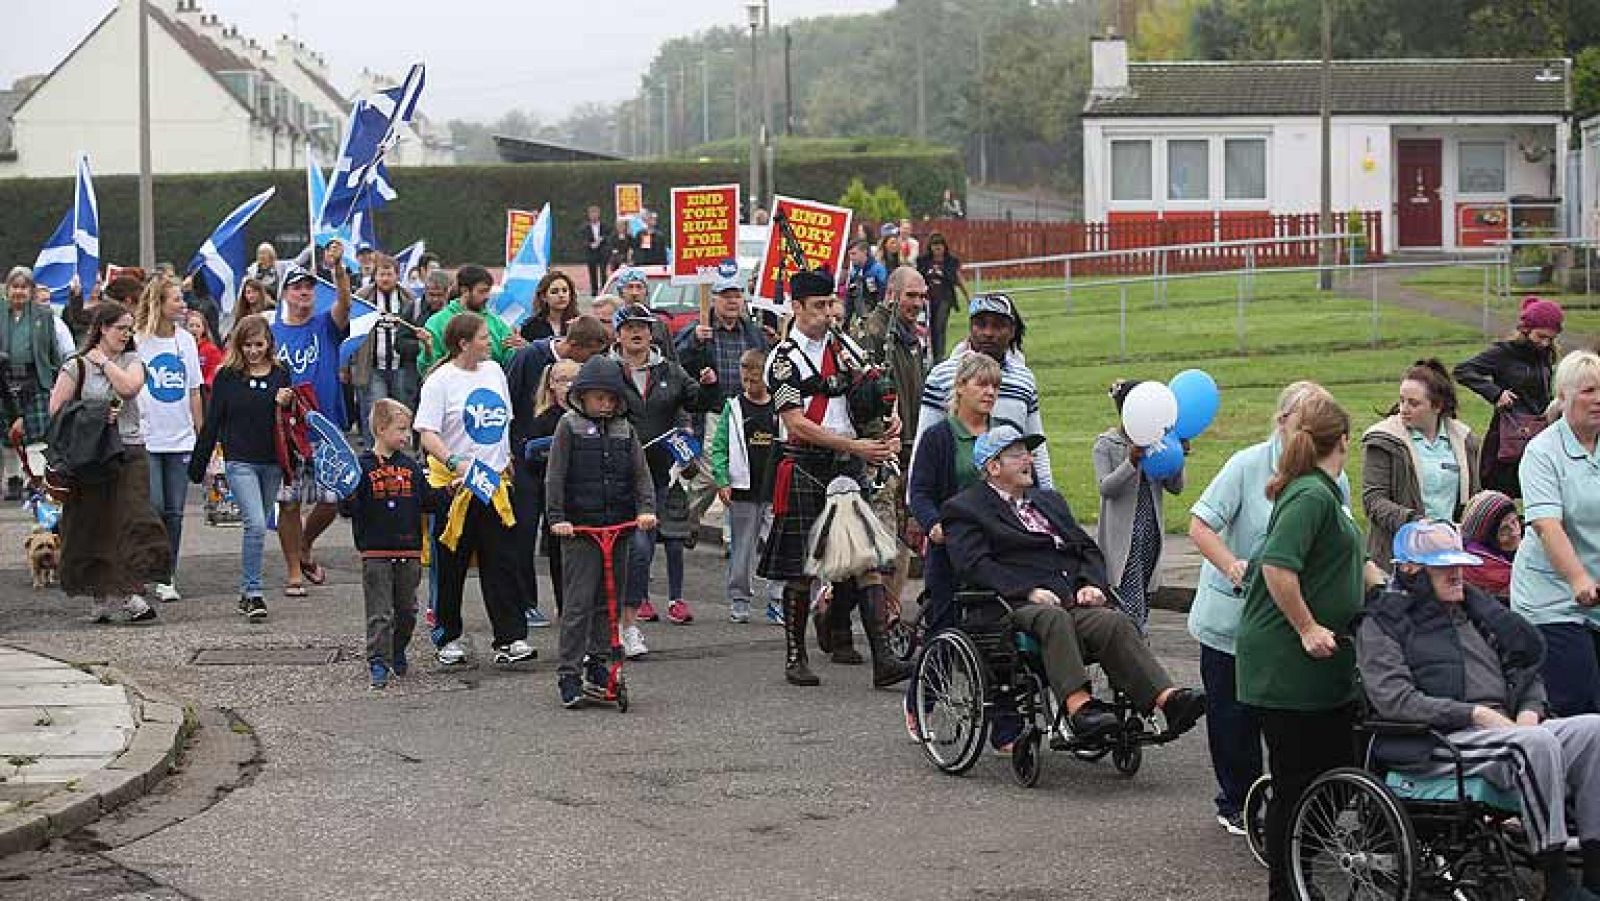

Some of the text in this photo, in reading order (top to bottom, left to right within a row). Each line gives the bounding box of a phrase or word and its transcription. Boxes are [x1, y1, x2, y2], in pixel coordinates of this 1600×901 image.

[687, 193, 724, 206] END
[682, 206, 729, 219] TORY
[789, 208, 832, 226] END
[682, 219, 728, 232] RULE
[687, 233, 724, 245] FOR
[788, 223, 836, 243] ORY
[682, 246, 729, 259] EVER
[149, 366, 185, 389] Yes
[465, 404, 507, 429] Yes
